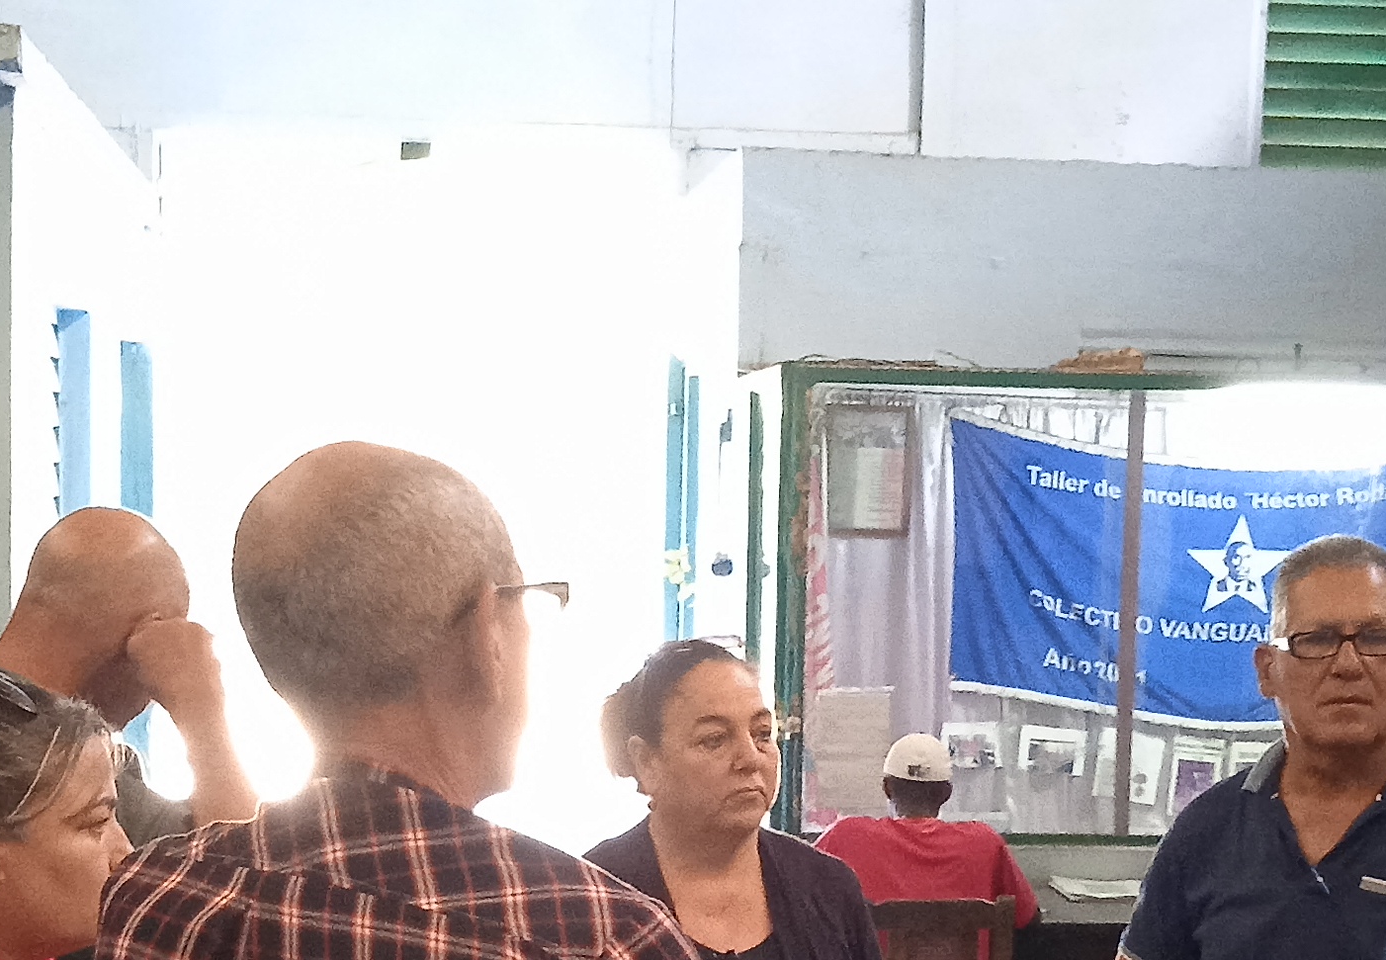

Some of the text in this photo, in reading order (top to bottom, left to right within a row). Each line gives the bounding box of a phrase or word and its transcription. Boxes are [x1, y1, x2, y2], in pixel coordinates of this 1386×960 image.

[1026, 465, 1089, 494] Taller
[1094, 479, 1121, 499] de
[1141, 488, 1238, 510] nrollado
[1029, 589, 1270, 643] COLECTIO VANGUA
[1043, 647, 1148, 684] Año 201
